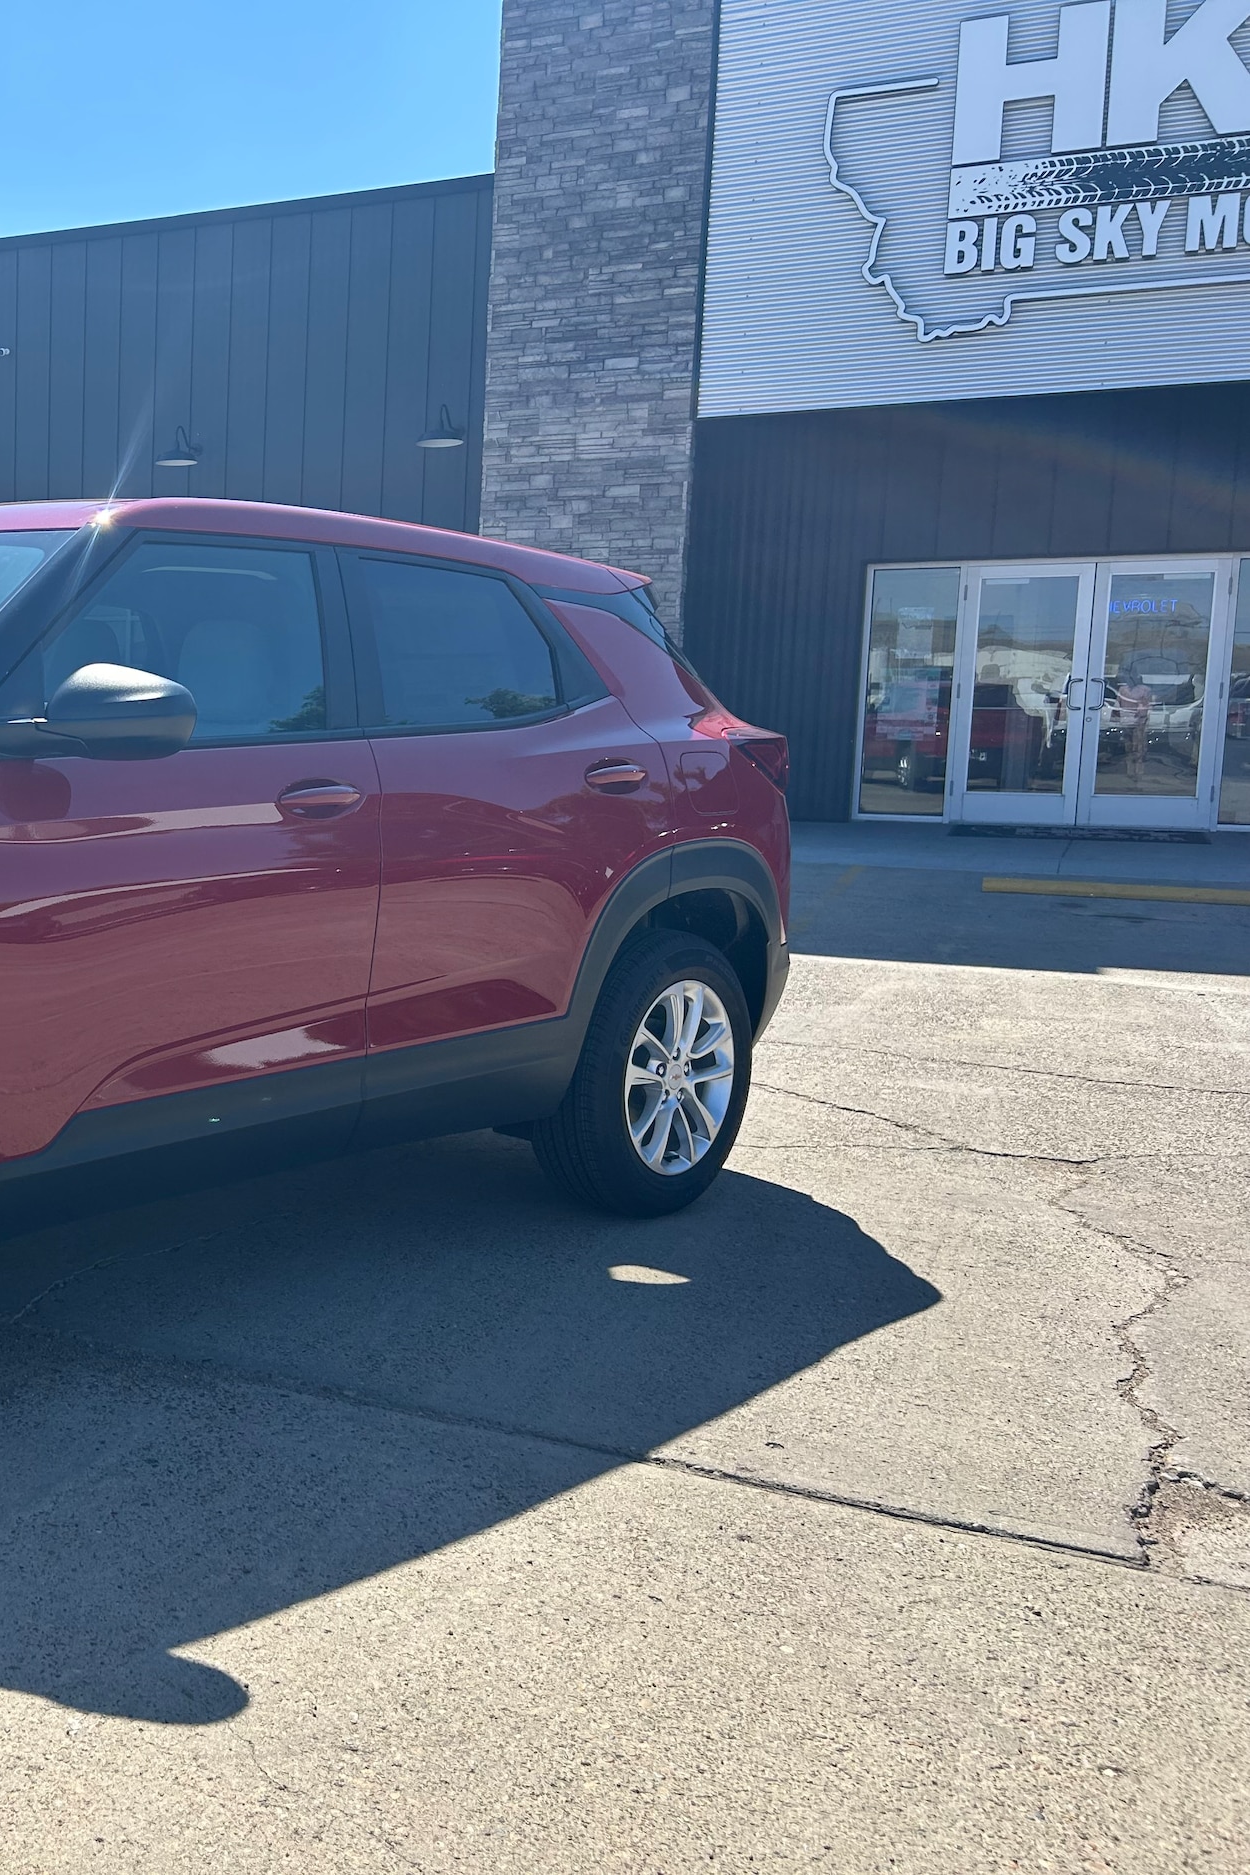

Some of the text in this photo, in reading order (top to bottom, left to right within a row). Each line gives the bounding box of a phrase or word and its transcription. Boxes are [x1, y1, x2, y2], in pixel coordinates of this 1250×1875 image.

[951, 0, 1250, 165] HK
[944, 192, 1250, 275] BIG SKY M
